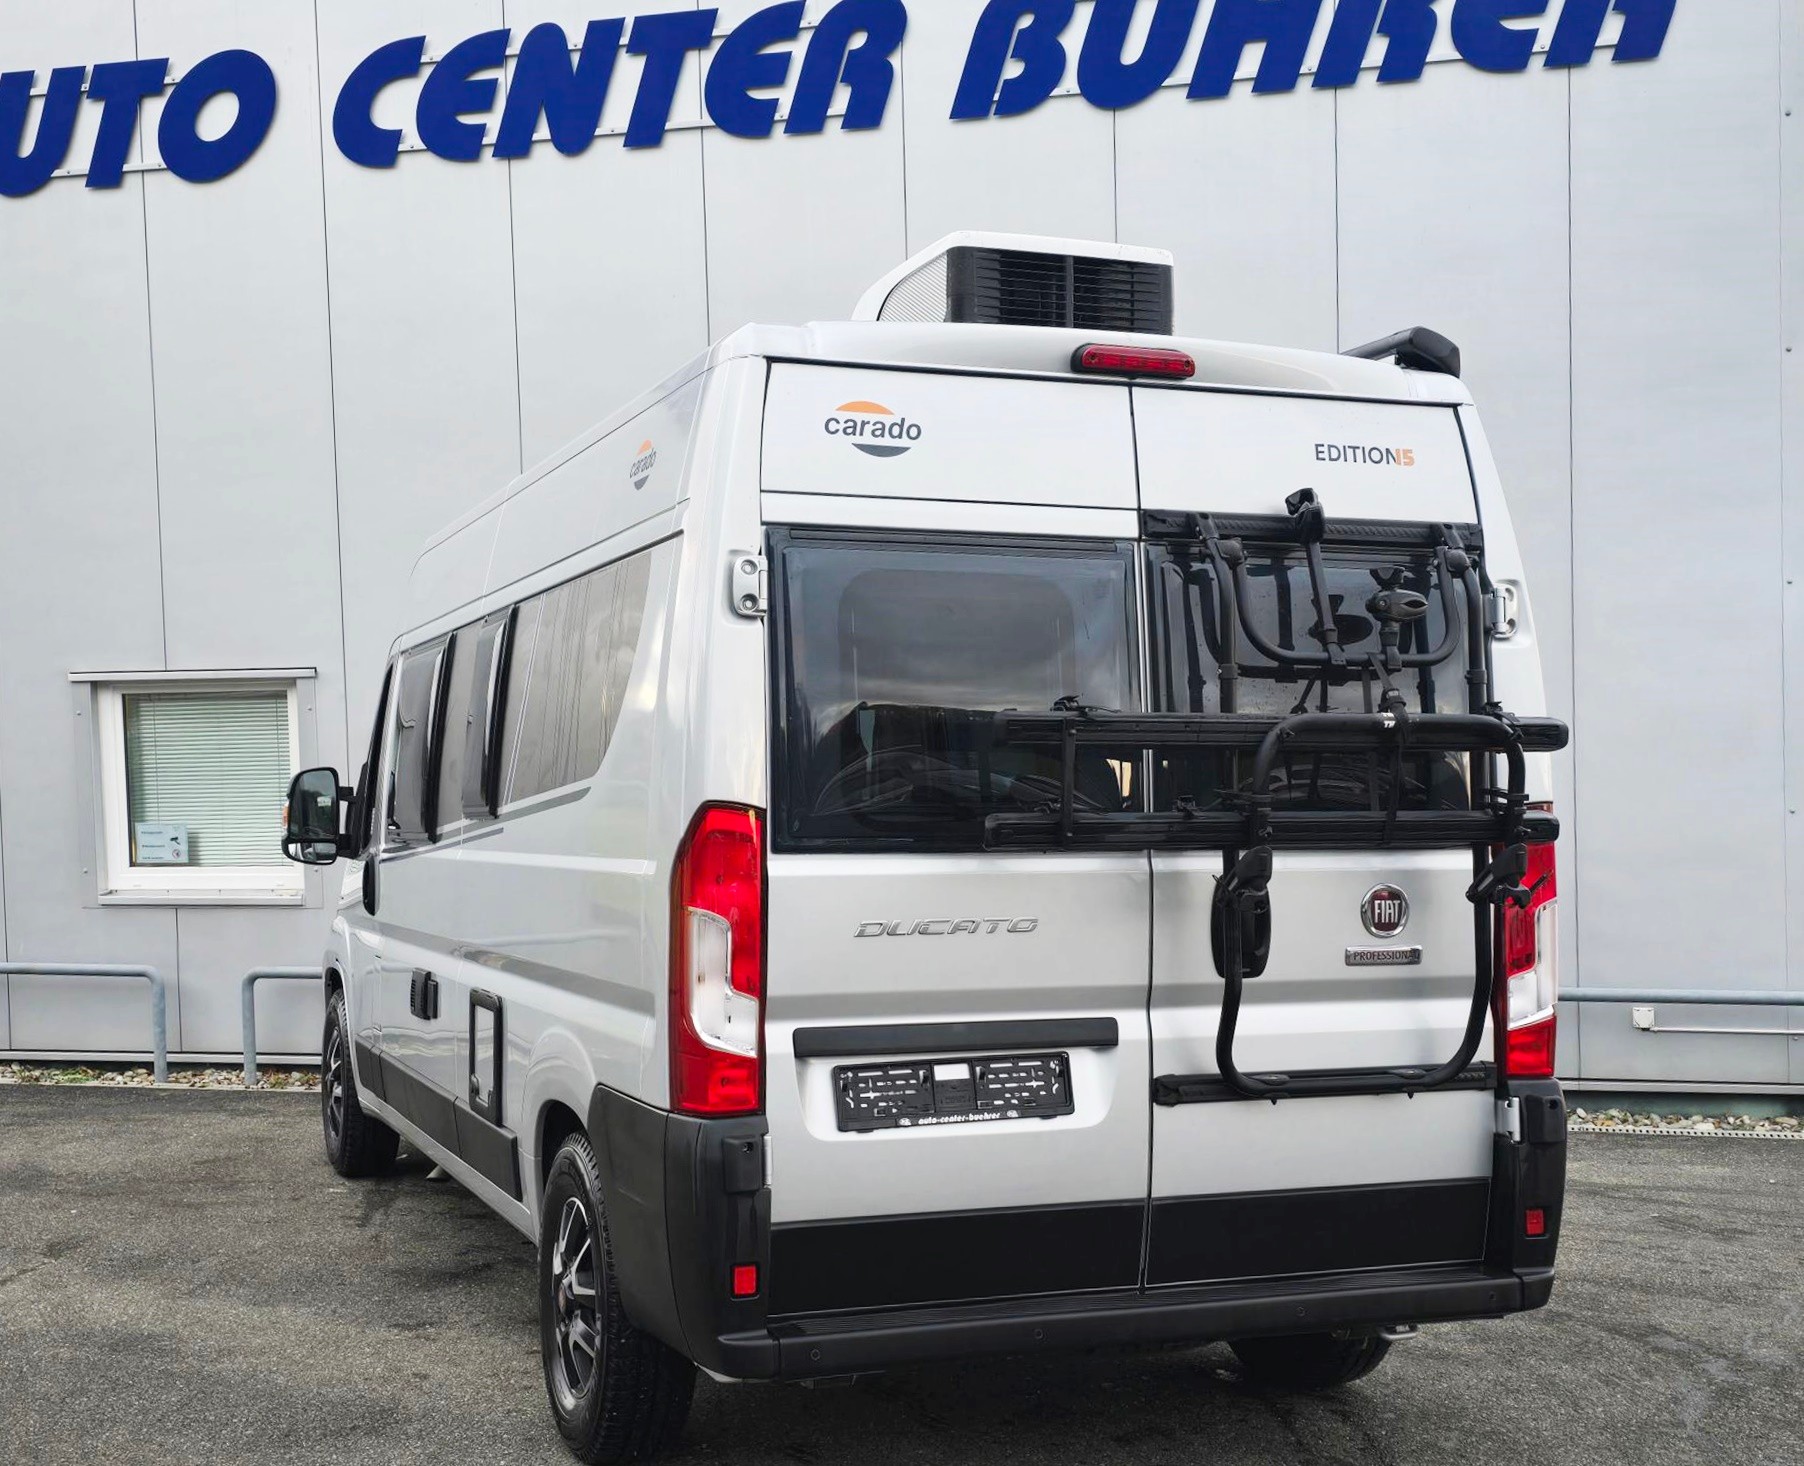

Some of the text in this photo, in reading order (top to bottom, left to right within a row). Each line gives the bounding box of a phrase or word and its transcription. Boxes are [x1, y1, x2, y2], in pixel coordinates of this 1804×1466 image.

[333, 0, 908, 168] CENTER
[824, 417, 922, 441] carado
[1374, 899, 1401, 923] FIAT
[854, 918, 1039, 938] DUCATO
